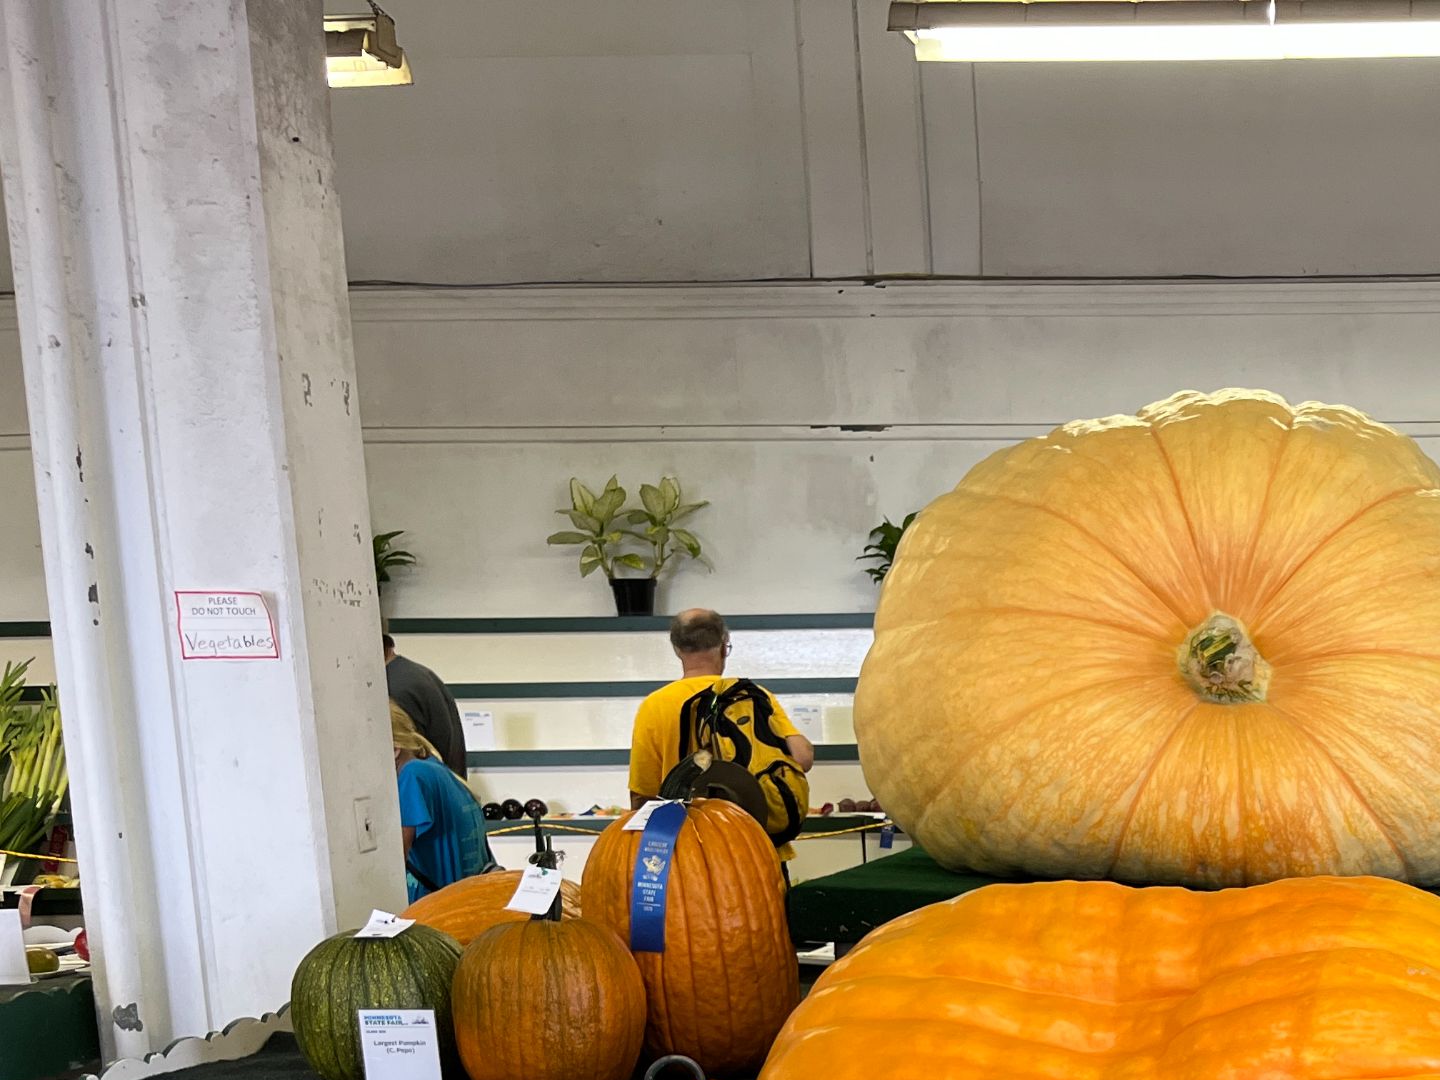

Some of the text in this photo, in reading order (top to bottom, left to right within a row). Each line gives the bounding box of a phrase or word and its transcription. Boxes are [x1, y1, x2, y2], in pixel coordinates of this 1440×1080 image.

[208, 597, 238, 605] PLEASE
[191, 607, 256, 615] DO NOT TOUCH
[185, 632, 274, 655] Vegetables
